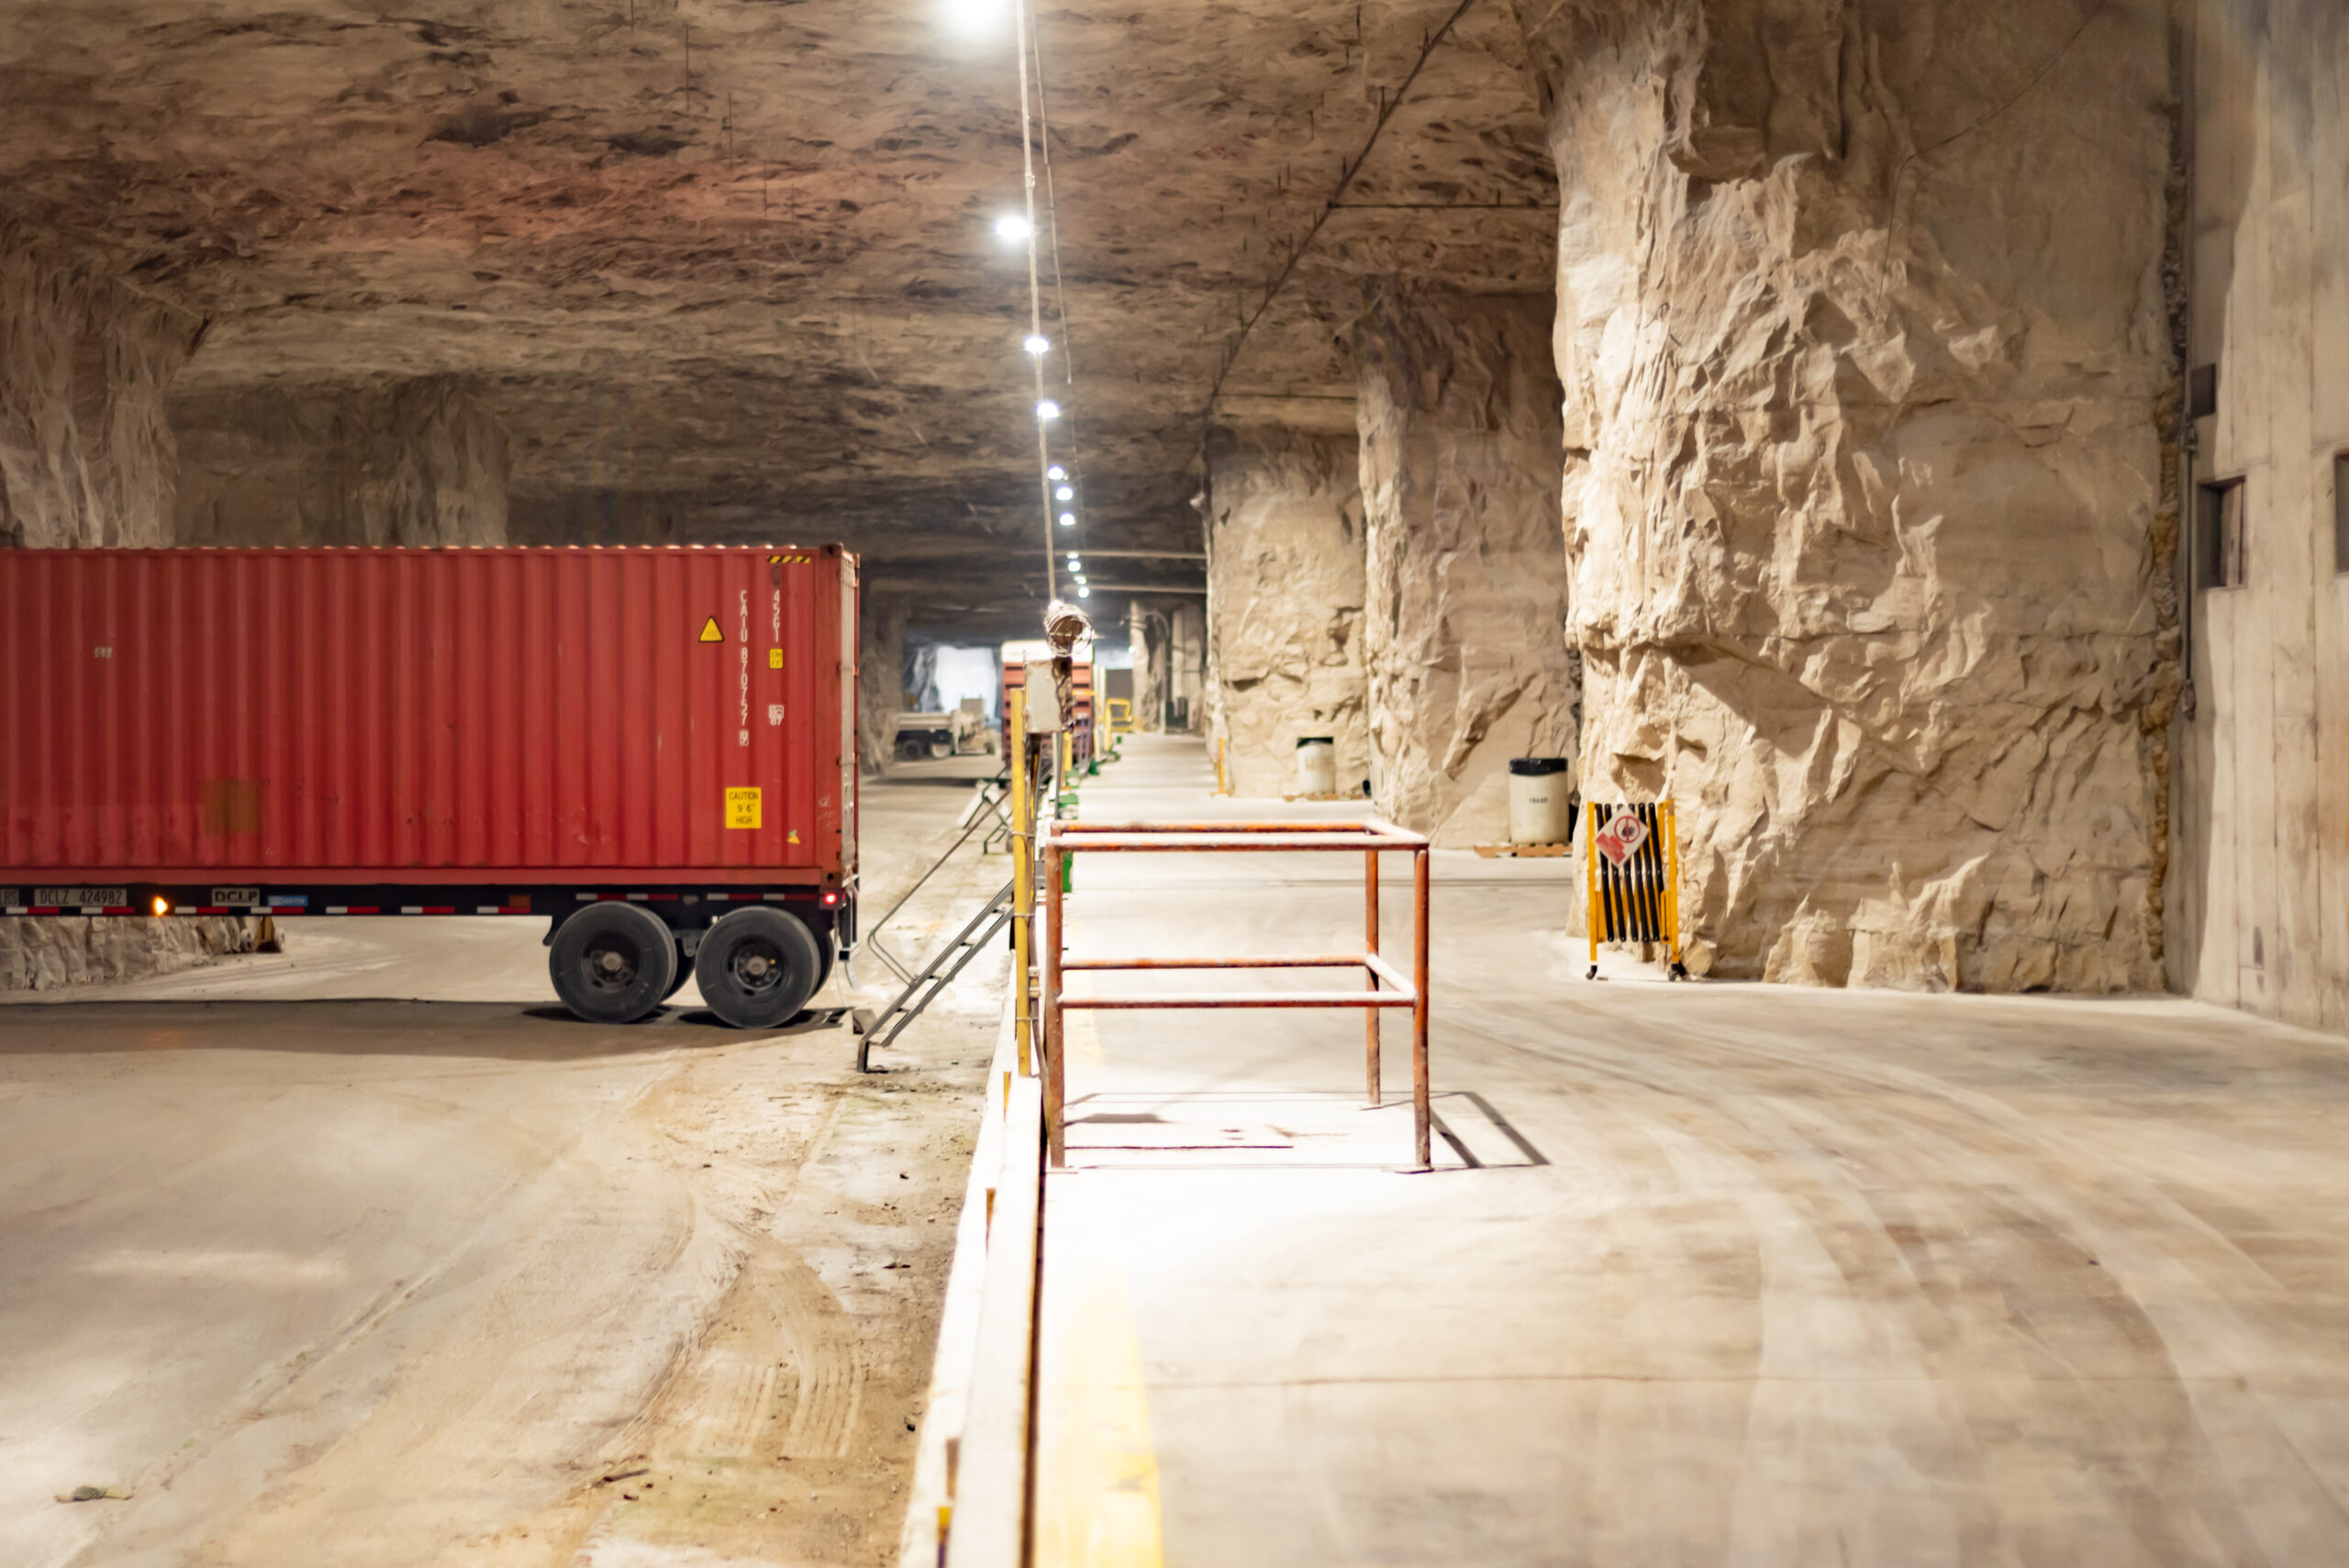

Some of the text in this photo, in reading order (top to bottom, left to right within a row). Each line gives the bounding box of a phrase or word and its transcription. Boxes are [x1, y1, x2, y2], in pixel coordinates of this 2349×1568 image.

[740, 590, 748, 642] CAIU
[740, 730, 749, 746] 9
[729, 791, 759, 800] CAUTION
[736, 816, 752, 825] HIGH
[79, 888, 123, 906] 424982
